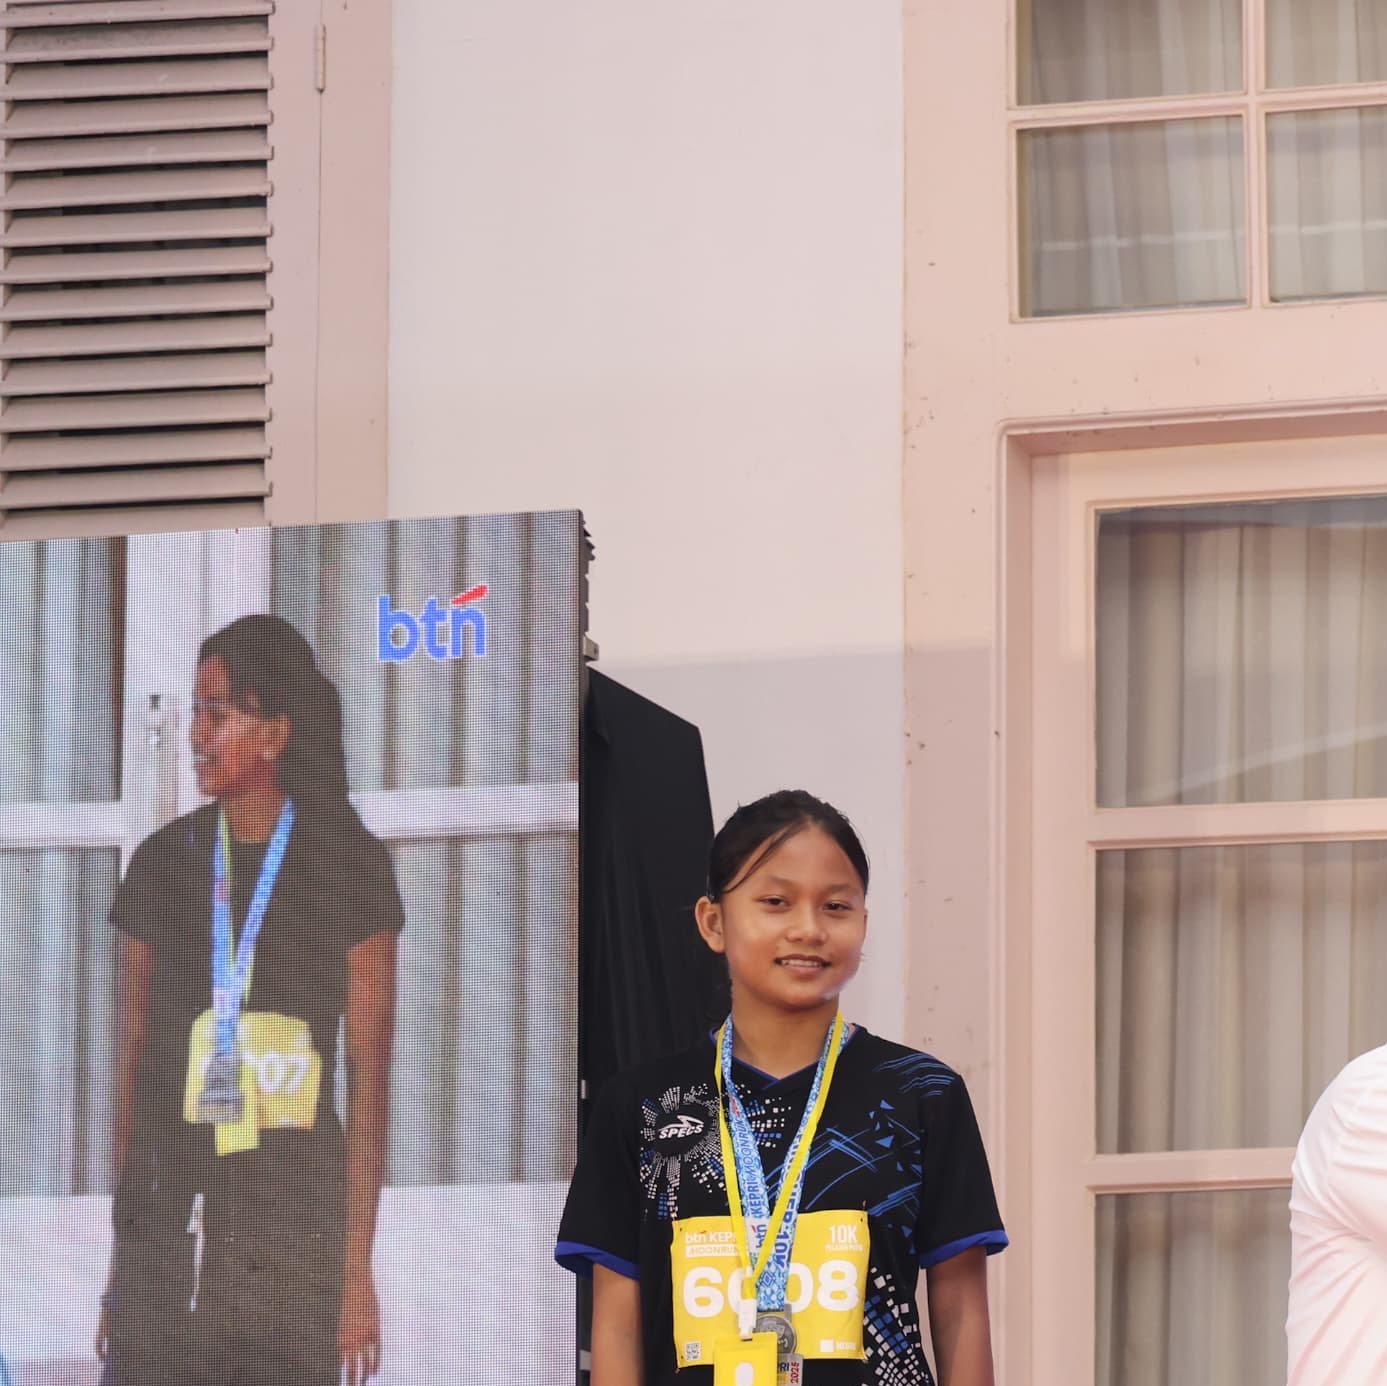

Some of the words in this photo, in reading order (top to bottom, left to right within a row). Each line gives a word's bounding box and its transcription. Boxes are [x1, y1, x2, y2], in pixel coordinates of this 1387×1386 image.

[377, 584, 488, 662] btn
[658, 1125, 703, 1140] SPECS
[828, 1224, 858, 1244] 10K
